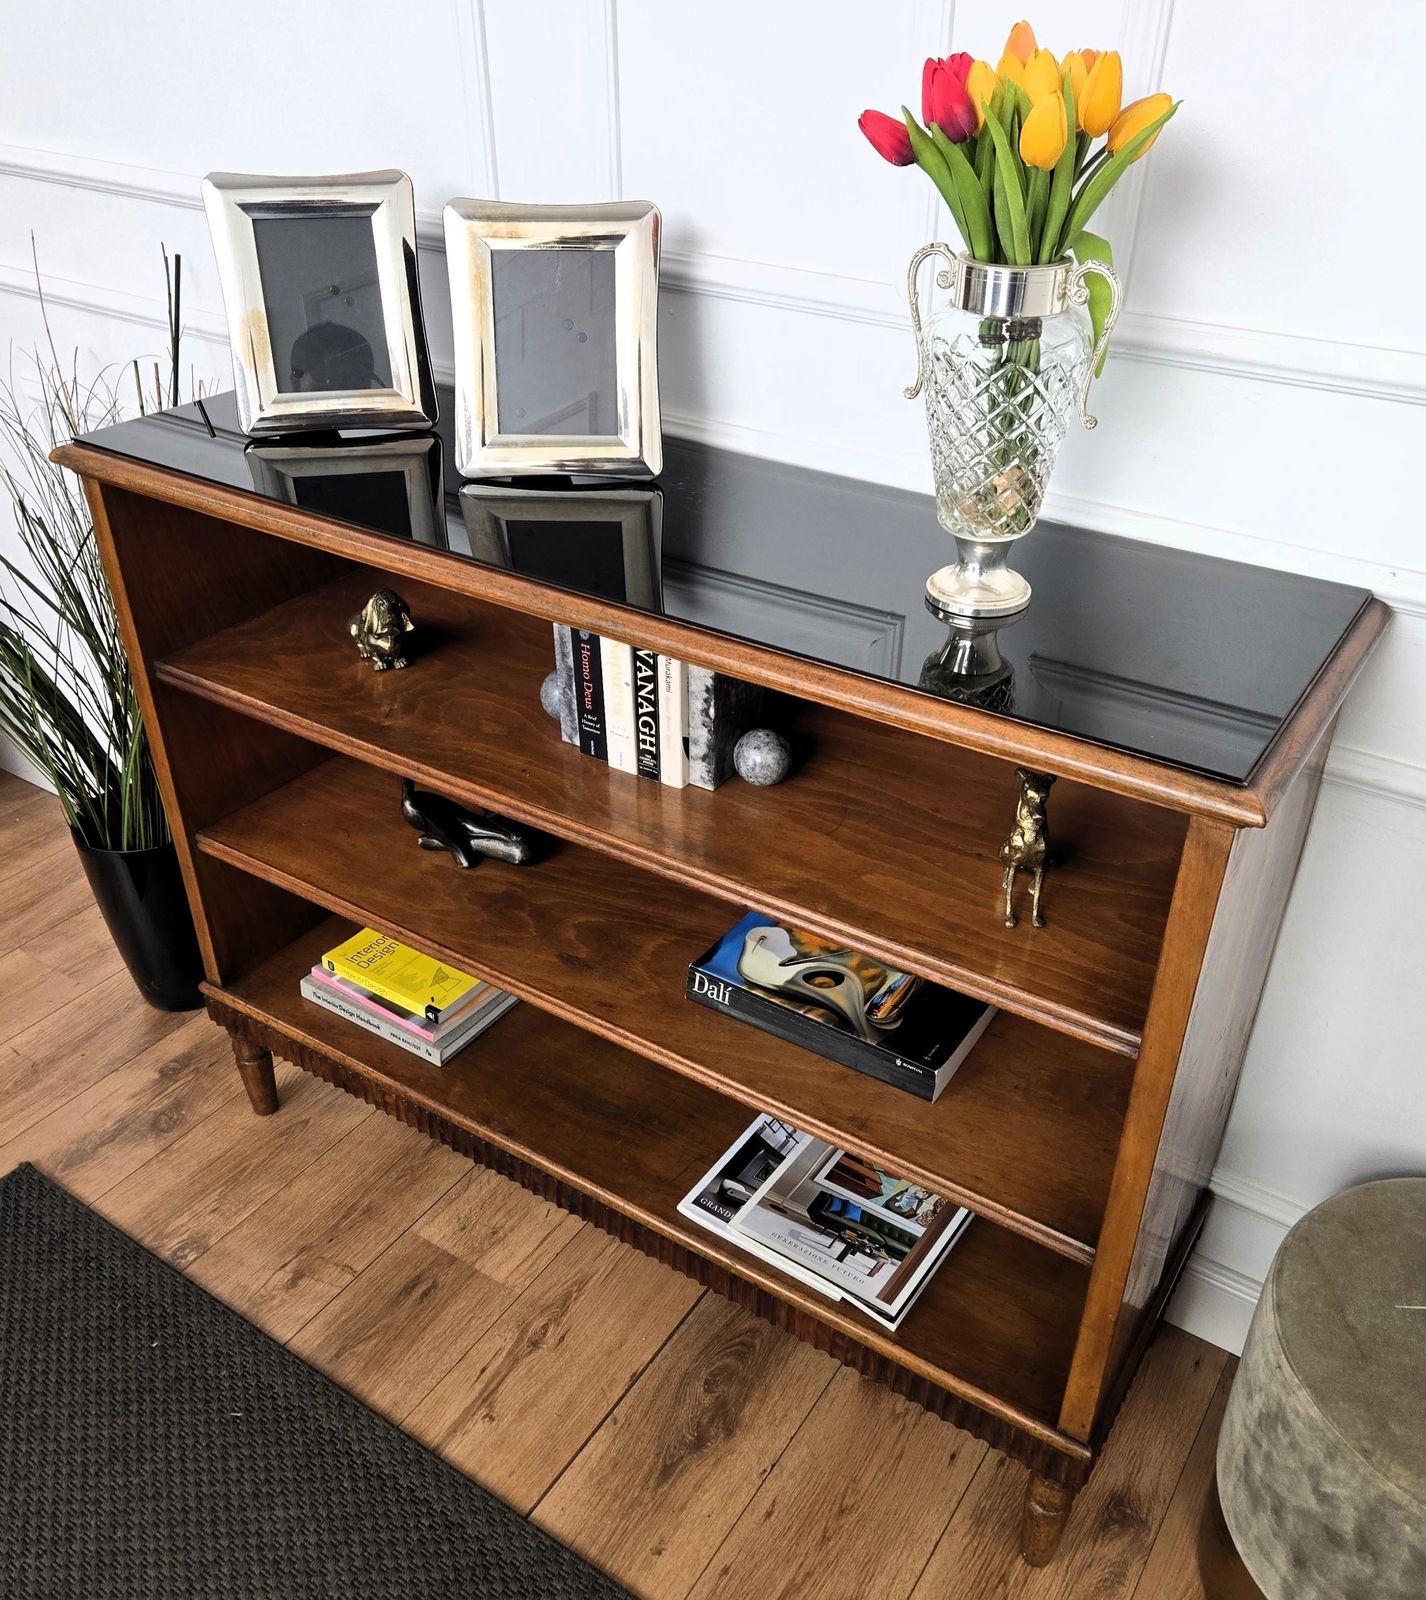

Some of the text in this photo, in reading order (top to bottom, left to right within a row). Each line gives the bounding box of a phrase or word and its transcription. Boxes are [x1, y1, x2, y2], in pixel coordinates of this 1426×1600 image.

[580, 643, 593, 710] Homo Deus
[345, 934, 390, 964] Interior
[356, 942, 400, 970] Design
[692, 971, 733, 1005] Dalí
[312, 991, 381, 1030] The Interior Design Handbook
[771, 1231, 865, 1284] GENERAZIONE FUTURO
